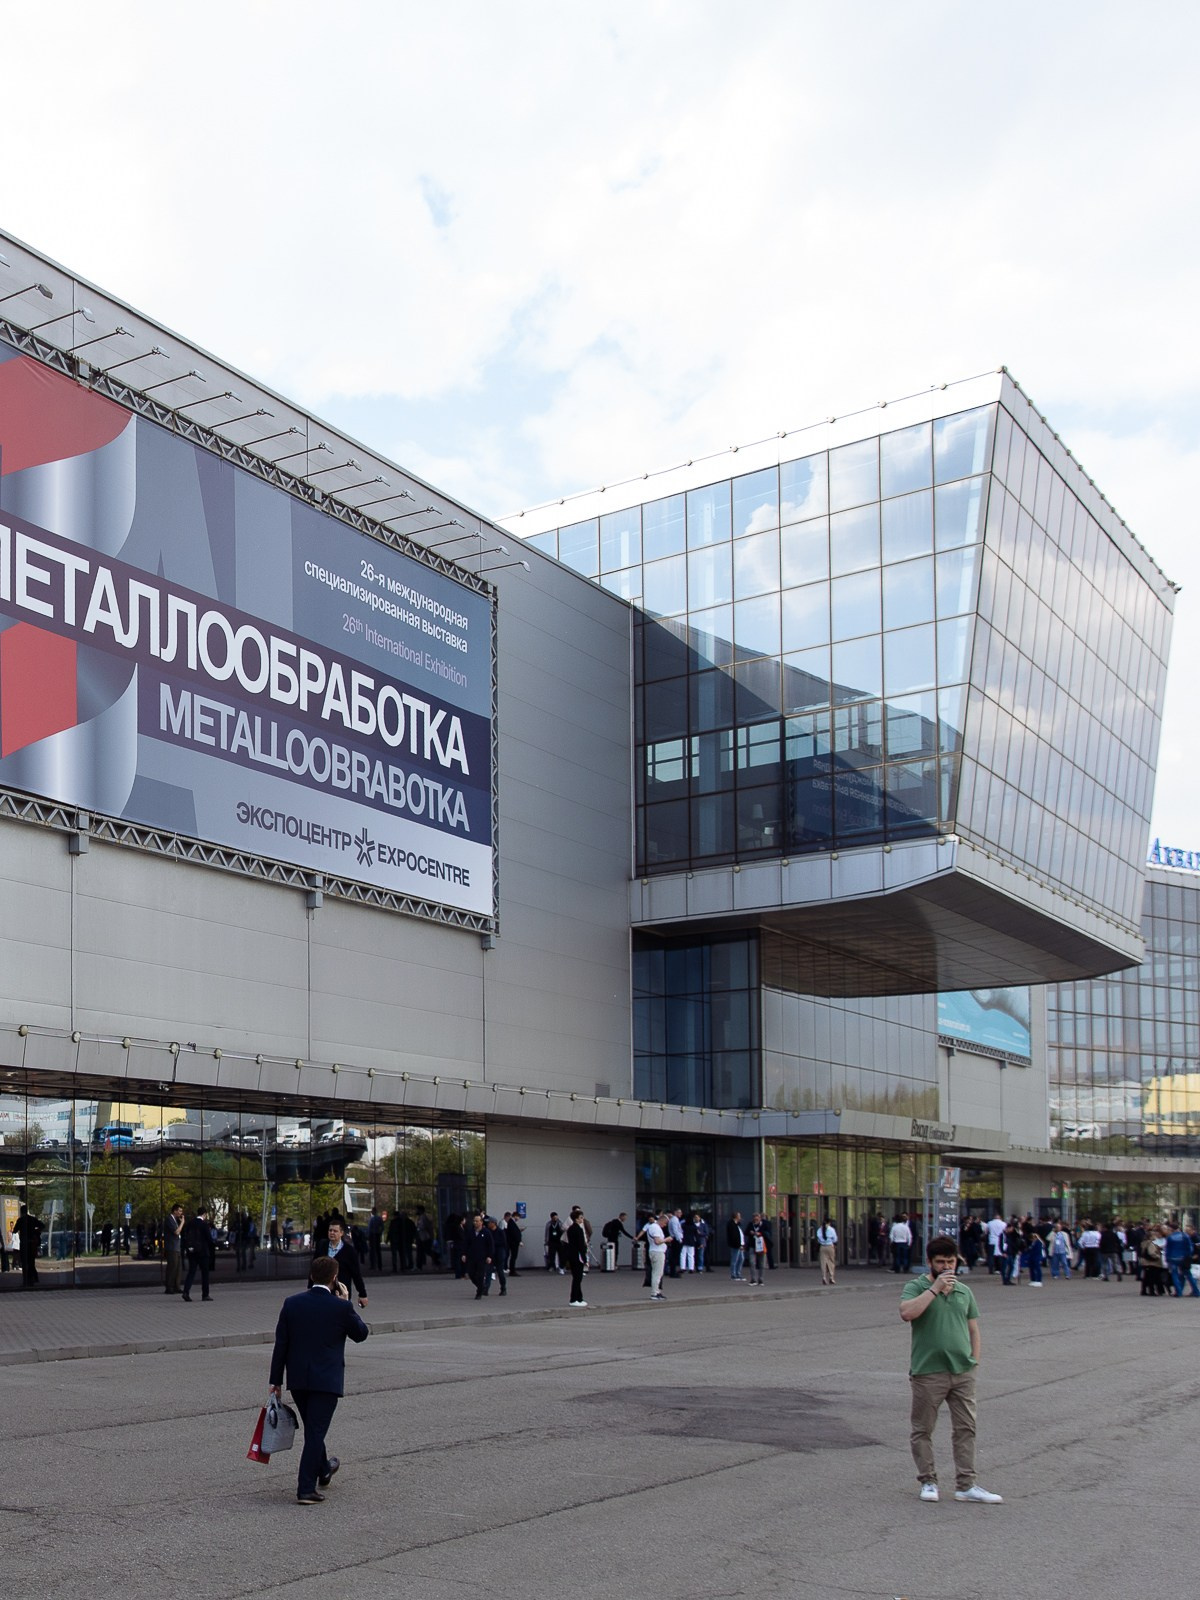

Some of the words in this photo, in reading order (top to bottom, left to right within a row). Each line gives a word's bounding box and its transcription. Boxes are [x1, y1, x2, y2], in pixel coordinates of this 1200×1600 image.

[304, 560, 420, 627] специализированная
[422, 618, 468, 654] выставка
[360, 559, 386, 588] 26-я
[387, 576, 468, 631] международная
[342, 613, 363, 635] 26th
[365, 623, 423, 667] International
[425, 652, 467, 688] Exhibition
[158, 682, 471, 833] METALLOOBRABOTKA
[236, 801, 353, 852] ЭКСПОЦЕНТР
[377, 843, 471, 887] EXPOCENTRE
